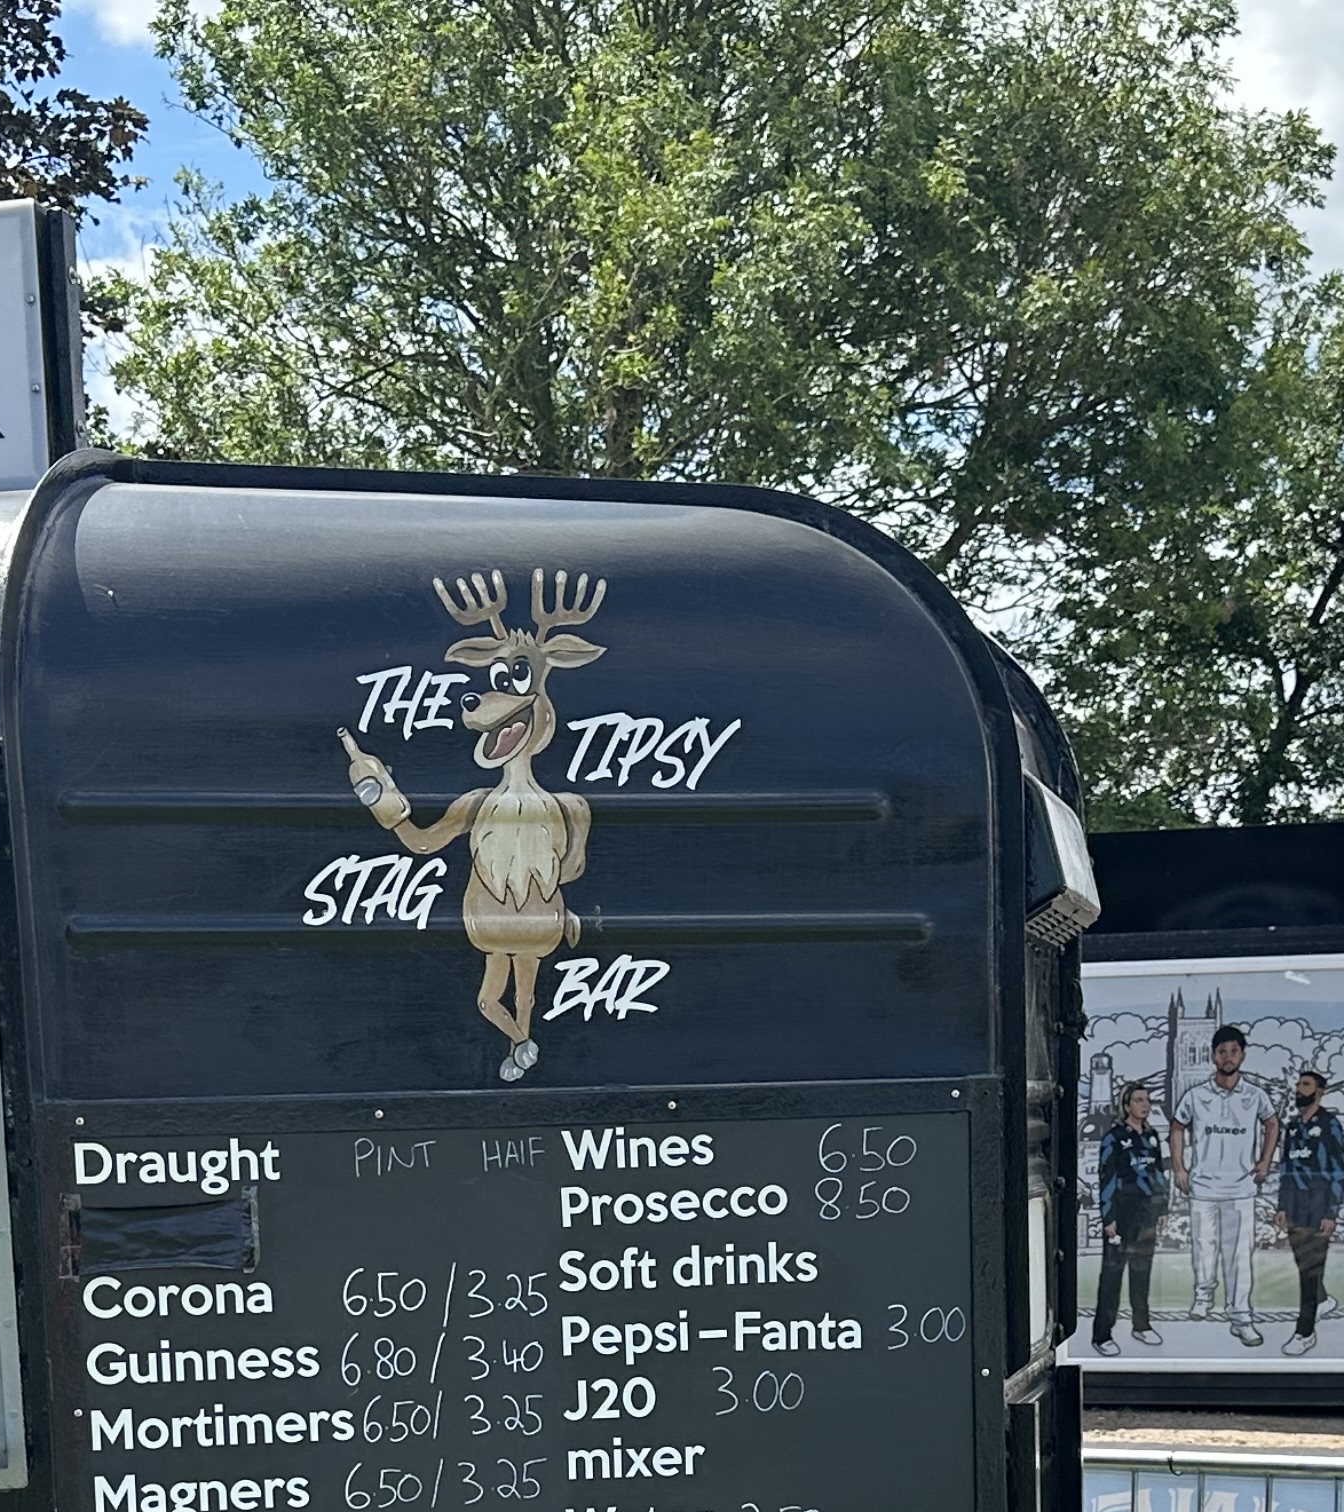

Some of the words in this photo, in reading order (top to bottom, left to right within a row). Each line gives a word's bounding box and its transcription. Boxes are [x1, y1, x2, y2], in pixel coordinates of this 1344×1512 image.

[356, 666, 471, 740] THE
[565, 712, 741, 791] TIPSY
[302, 854, 448, 930] STAG
[542, 953, 671, 1022] BAR
[74, 1138, 281, 1195] Draught
[355, 1137, 436, 1178] PINT
[561, 1127, 715, 1171] Wines
[560, 1184, 788, 1228] Prosecco
[559, 1246, 656, 1292] Soft
[672, 1241, 818, 1288] drinks
[82, 1276, 273, 1320] Corona
[86, 1340, 320, 1385] Guinness
[90, 1403, 355, 1451] Mortimers
[567, 1437, 705, 1481] mixer
